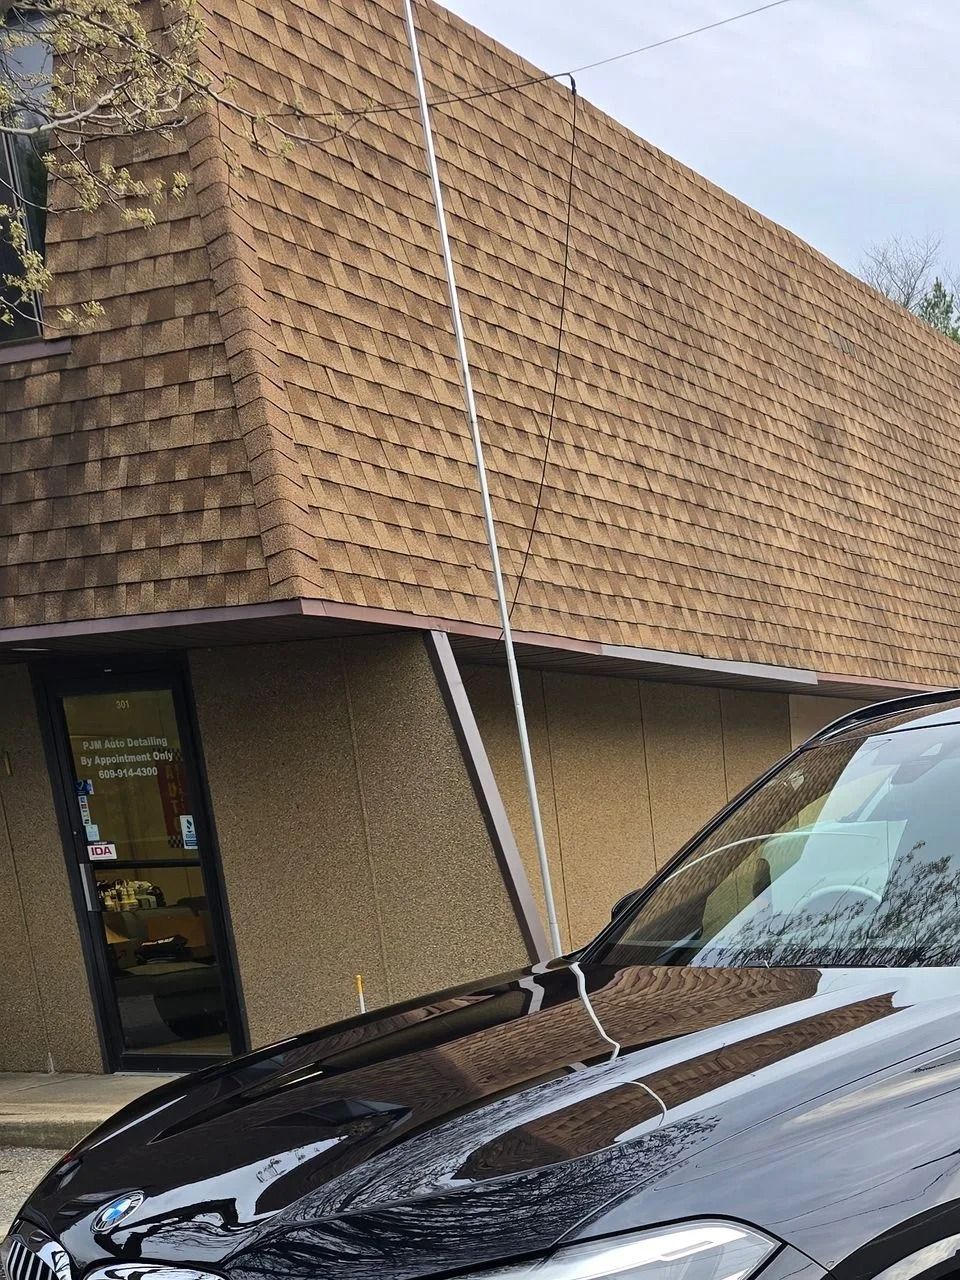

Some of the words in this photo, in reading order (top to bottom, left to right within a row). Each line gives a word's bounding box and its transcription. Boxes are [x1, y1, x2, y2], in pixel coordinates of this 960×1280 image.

[116, 700, 130, 710] 301
[83, 740, 102, 750] PJM
[104, 739, 125, 748] Auto
[127, 737, 168, 747] Detailing
[81, 756, 92, 766] By
[95, 753, 151, 766] Appointment
[153, 751, 173, 761] Only
[99, 767, 158, 779] 609-914-4300
[91, 846, 112, 856] IDA
